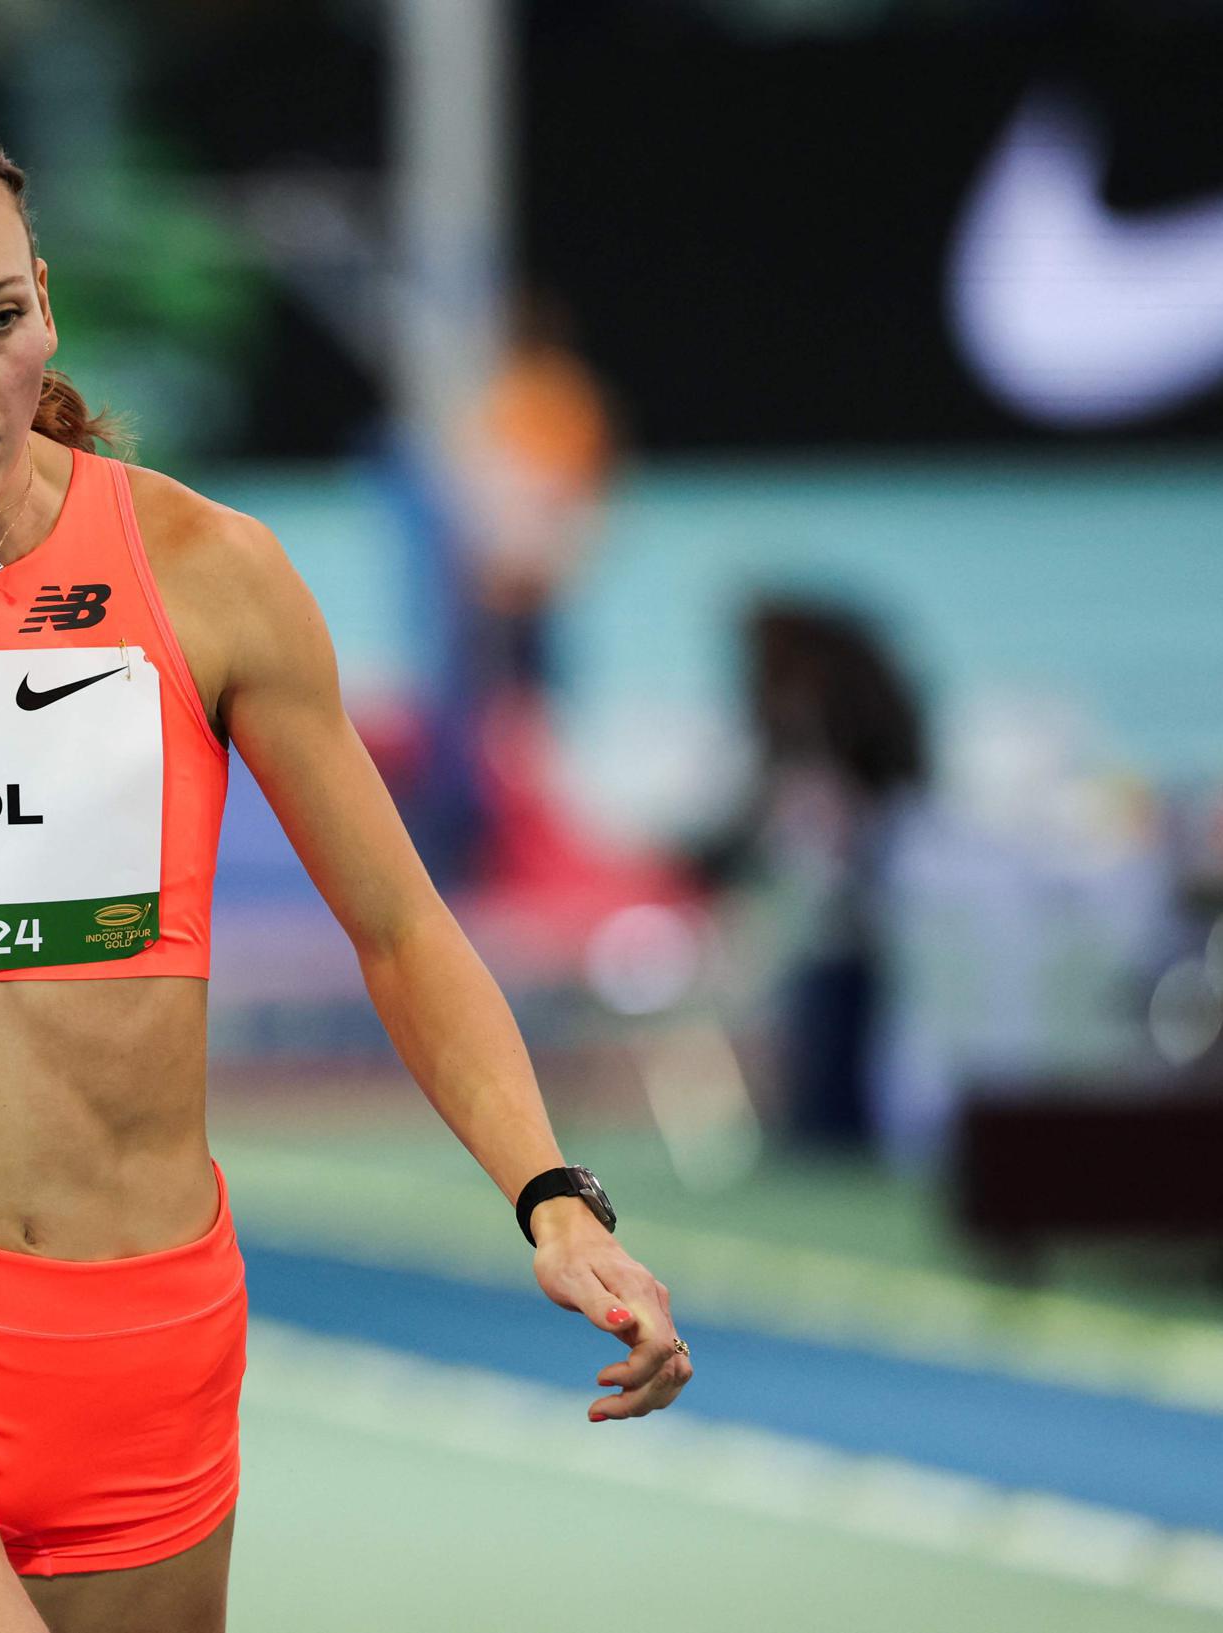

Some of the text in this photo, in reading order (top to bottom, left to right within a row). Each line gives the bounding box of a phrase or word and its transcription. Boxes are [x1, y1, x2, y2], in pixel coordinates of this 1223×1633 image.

[85, 931, 123, 943] INDOOR
[125, 928, 151, 939] TOUR
[105, 939, 132, 949] GOLD
